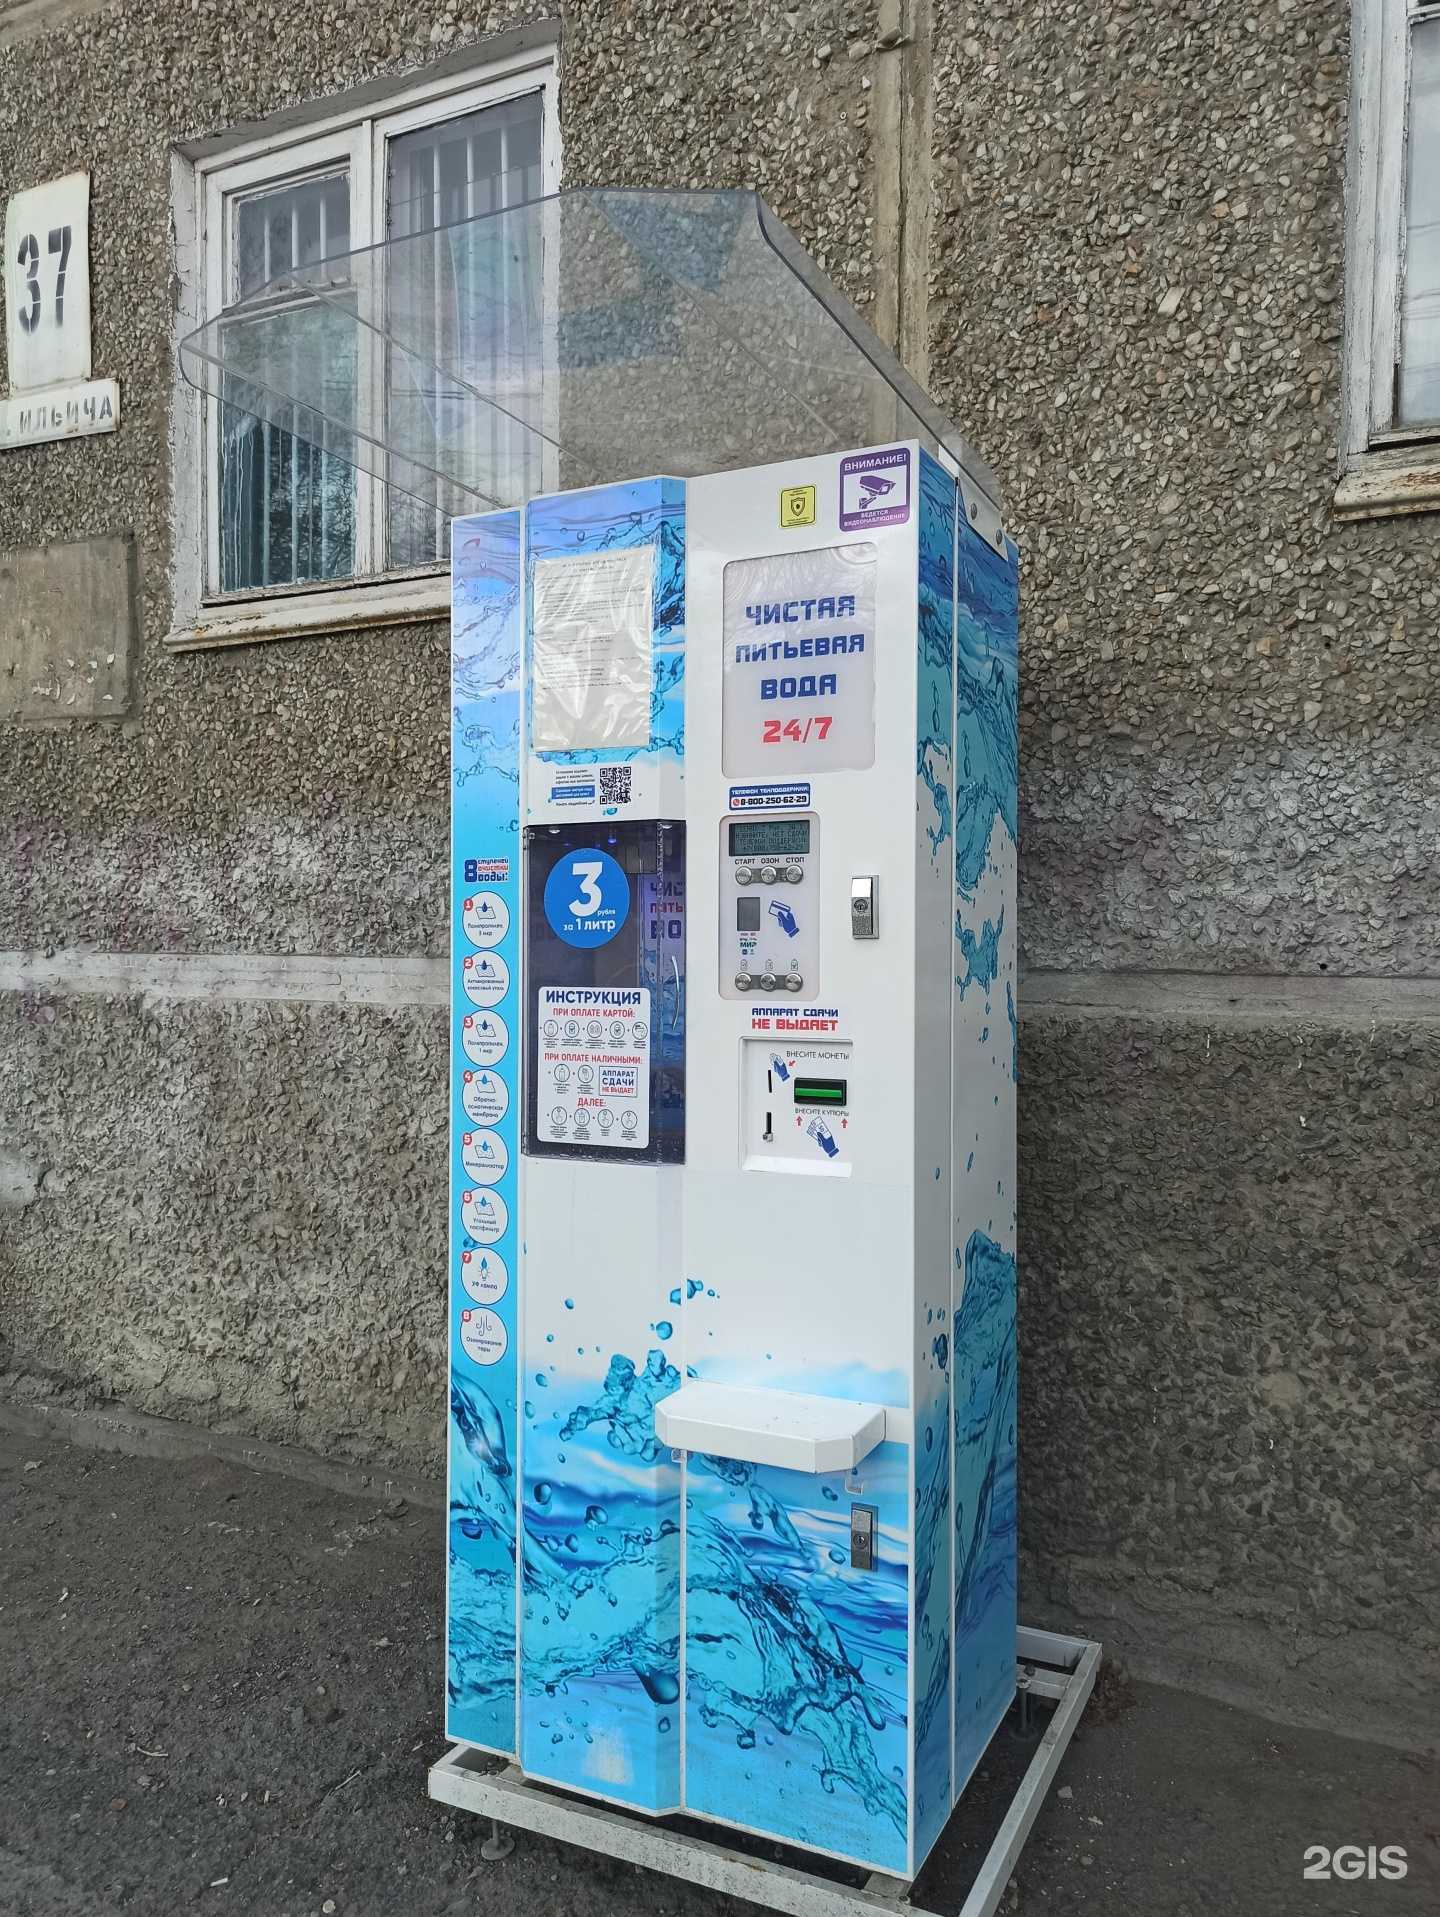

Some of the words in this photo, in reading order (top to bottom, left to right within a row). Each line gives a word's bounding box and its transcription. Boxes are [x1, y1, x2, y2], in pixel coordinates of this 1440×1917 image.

[17, 225, 72, 334] 37
[20, 395, 113, 433] ИЛЬИЧА
[844, 453, 907, 471] ВНИМАНИЕ!
[843, 513, 905, 527] ВИДЕОНАБЛЮДЕНИЕ
[746, 595, 855, 625] ЧИСТАЯ
[735, 633, 865, 663] ПИТЬЕВАЯ
[760, 673, 837, 700] ВОДА
[763, 716, 833, 743] 24/7
[740, 795, 807, 805] 8-800-250-62-29
[464, 859, 477, 882] 8
[568, 861, 603, 917] 3
[597, 908, 616, 917] рубля
[575, 918, 582, 930] 1
[583, 919, 616, 932] литр
[465, 959, 472, 967] 2
[546, 990, 641, 1006] ИНСТРУКЦИЯ
[553, 1007, 568, 1016] ПРИ
[571, 1008, 601, 1017] ОПЛАТЕ
[603, 1008, 636, 1018] КАРТОЙ:
[752, 1007, 799, 1017] АППАРАТ
[803, 1008, 839, 1017] СДАЧИ
[465, 1017, 472, 1026] 3
[752, 1018, 770, 1030] НЕ
[776, 1018, 839, 1031] ВЫДАЕТ
[544, 1052, 559, 1061] ПРИ
[561, 1053, 590, 1062] ОПЛАТЕ
[591, 1054, 643, 1064] НАЛИЧНЫМИ:
[786, 1050, 816, 1058] ВНЕСИТЕ
[818, 1051, 850, 1060] МОНЕТЫ
[464, 1072, 472, 1081] 4
[602, 1070, 635, 1078] АППАРАТ
[602, 1077, 635, 1086] СДАЧИ
[577, 1097, 607, 1107] ДАЛЕЕ:
[822, 1109, 849, 1117] КУПЮРЫ
[464, 1135, 471, 1143] 5
[464, 1253, 470, 1262] 7
